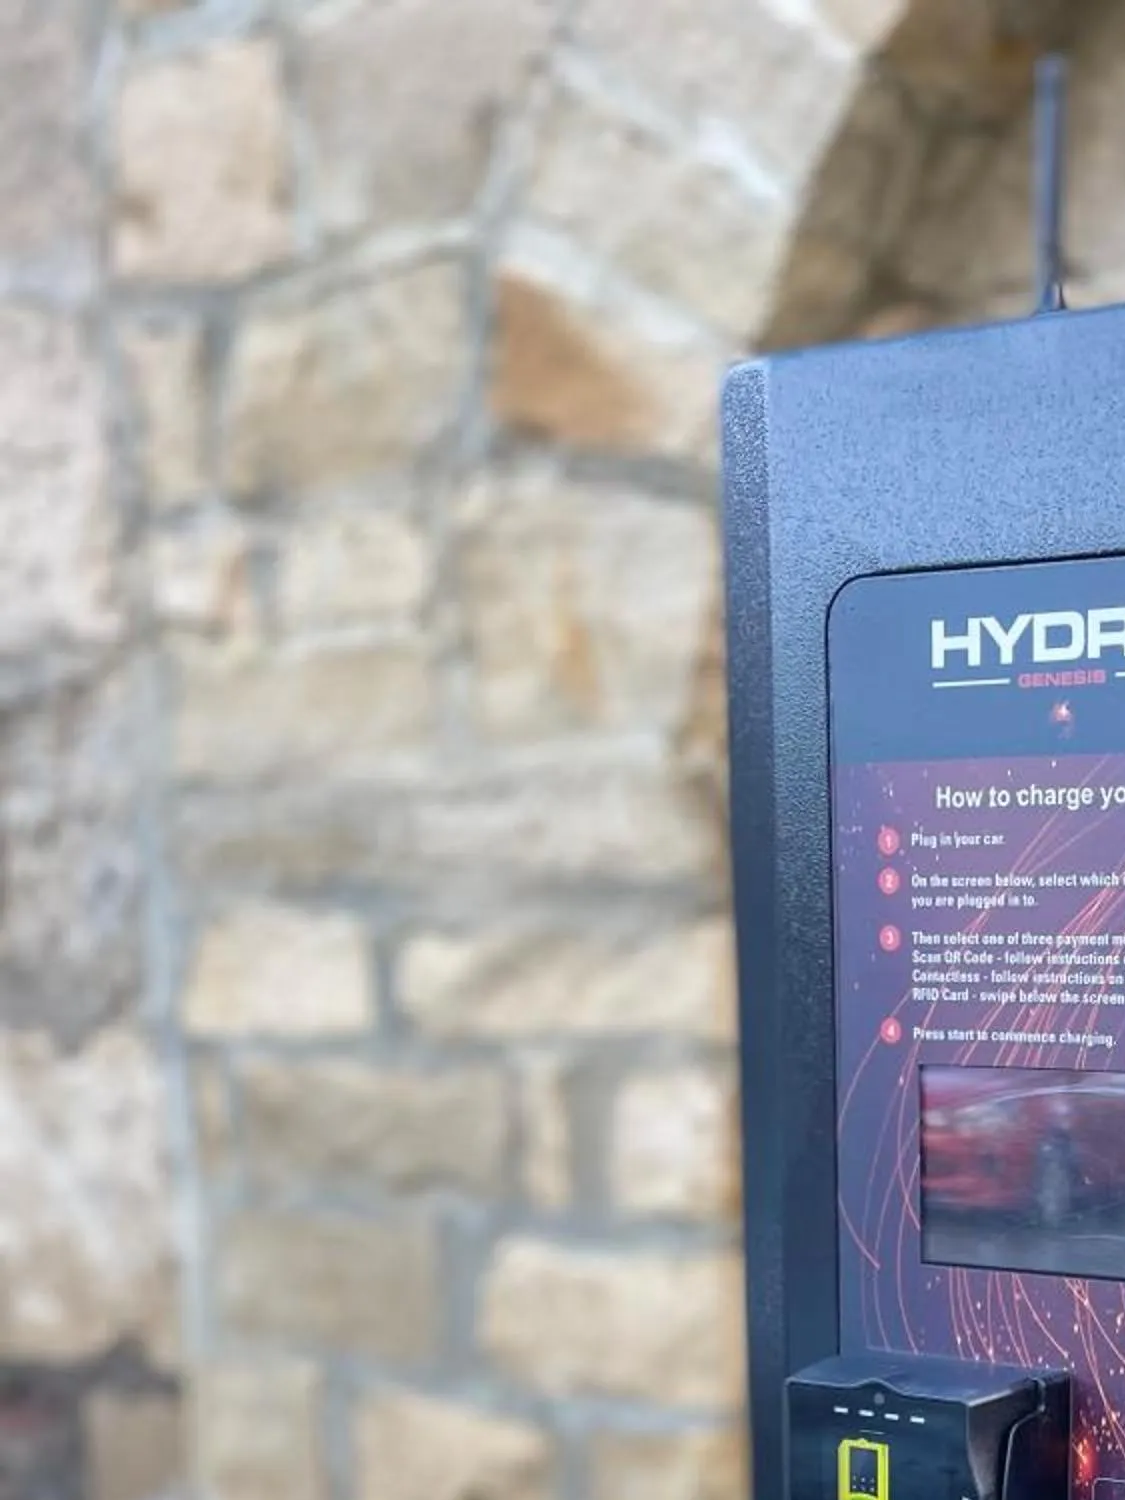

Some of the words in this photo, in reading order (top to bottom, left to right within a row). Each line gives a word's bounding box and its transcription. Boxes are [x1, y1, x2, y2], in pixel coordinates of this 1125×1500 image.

[1018, 669, 1107, 688] GENESIS
[936, 785, 983, 809] How
[988, 785, 1011, 808] to
[1015, 783, 1095, 812] charge
[911, 832, 937, 849] Plug
[939, 832, 952, 847] in
[953, 832, 980, 849] your
[911, 873, 927, 888] On
[929, 873, 948, 887] the
[951, 875, 992, 888] screen
[995, 873, 1036, 889] below,
[1039, 873, 1077, 887] select
[1079, 872, 1119, 887] which
[911, 894, 932, 910] you
[934, 895, 955, 908] are
[957, 893, 1005, 910] plugged
[1008, 894, 1020, 907] in
[1022, 894, 1040, 907] to.
[911, 931, 941, 946] Then
[943, 931, 980, 946] select
[982, 933, 1005, 946] one
[1007, 931, 1020, 945] of
[1021, 932, 1053, 946] three
[1055, 933, 1109, 949] payment
[911, 950, 941, 964] Scan
[943, 950, 962, 965] QR
[963, 950, 994, 965] Code
[1004, 951, 1045, 965] follow
[1047, 952, 1120, 966] instructions
[911, 968, 981, 983] Contactless
[991, 970, 1030, 983] follow
[1032, 971, 1107, 985] instructions
[1109, 973, 1123, 985] on
[911, 987, 940, 1002] RFID
[942, 987, 970, 1002] Card
[980, 990, 1016, 1006] swipe
[1019, 989, 1058, 1003] below
[1060, 990, 1082, 1004] the
[1083, 992, 1125, 1005] screen
[912, 1027, 945, 1041] Press
[947, 1028, 974, 1041] start
[976, 1028, 988, 1041] to
[991, 1030, 1056, 1044] commence
[1059, 1028, 1117, 1048] charging.
